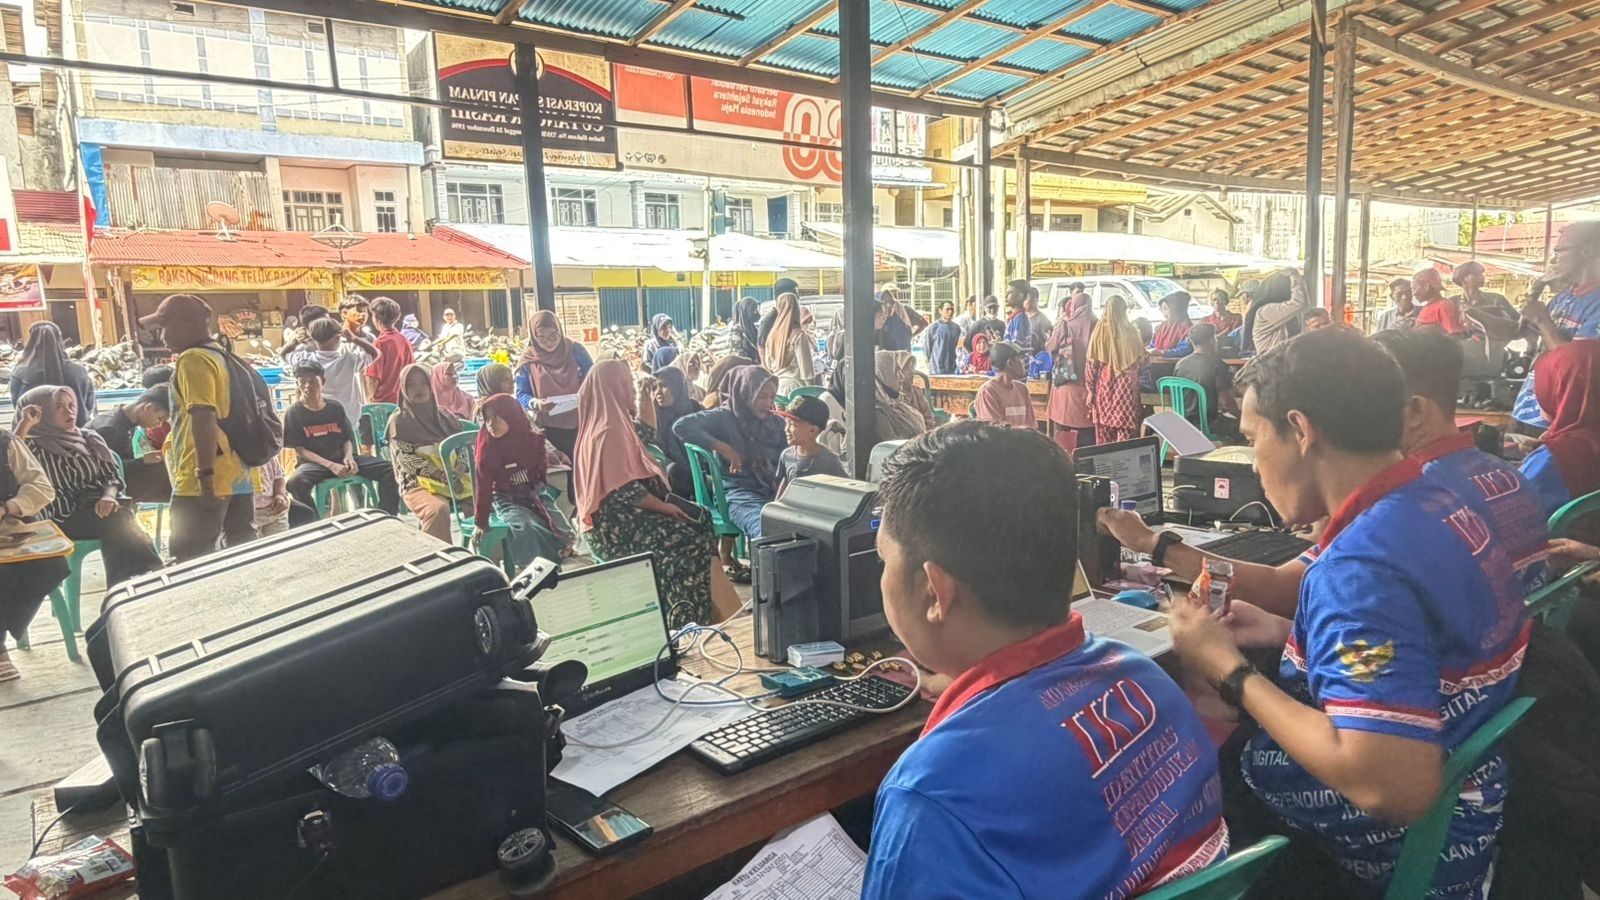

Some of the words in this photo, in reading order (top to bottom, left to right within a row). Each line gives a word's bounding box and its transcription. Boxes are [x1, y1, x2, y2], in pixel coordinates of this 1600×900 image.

[158, 269, 193, 286] BAKSO
[370, 272, 397, 286] BAKSO
[398, 272, 431, 286] SIMPANG
[432, 272, 456, 286] TELUK
[457, 272, 486, 286] BATANG
[1439, 682, 1489, 721] GITAL
[1060, 679, 1156, 778] IKD
